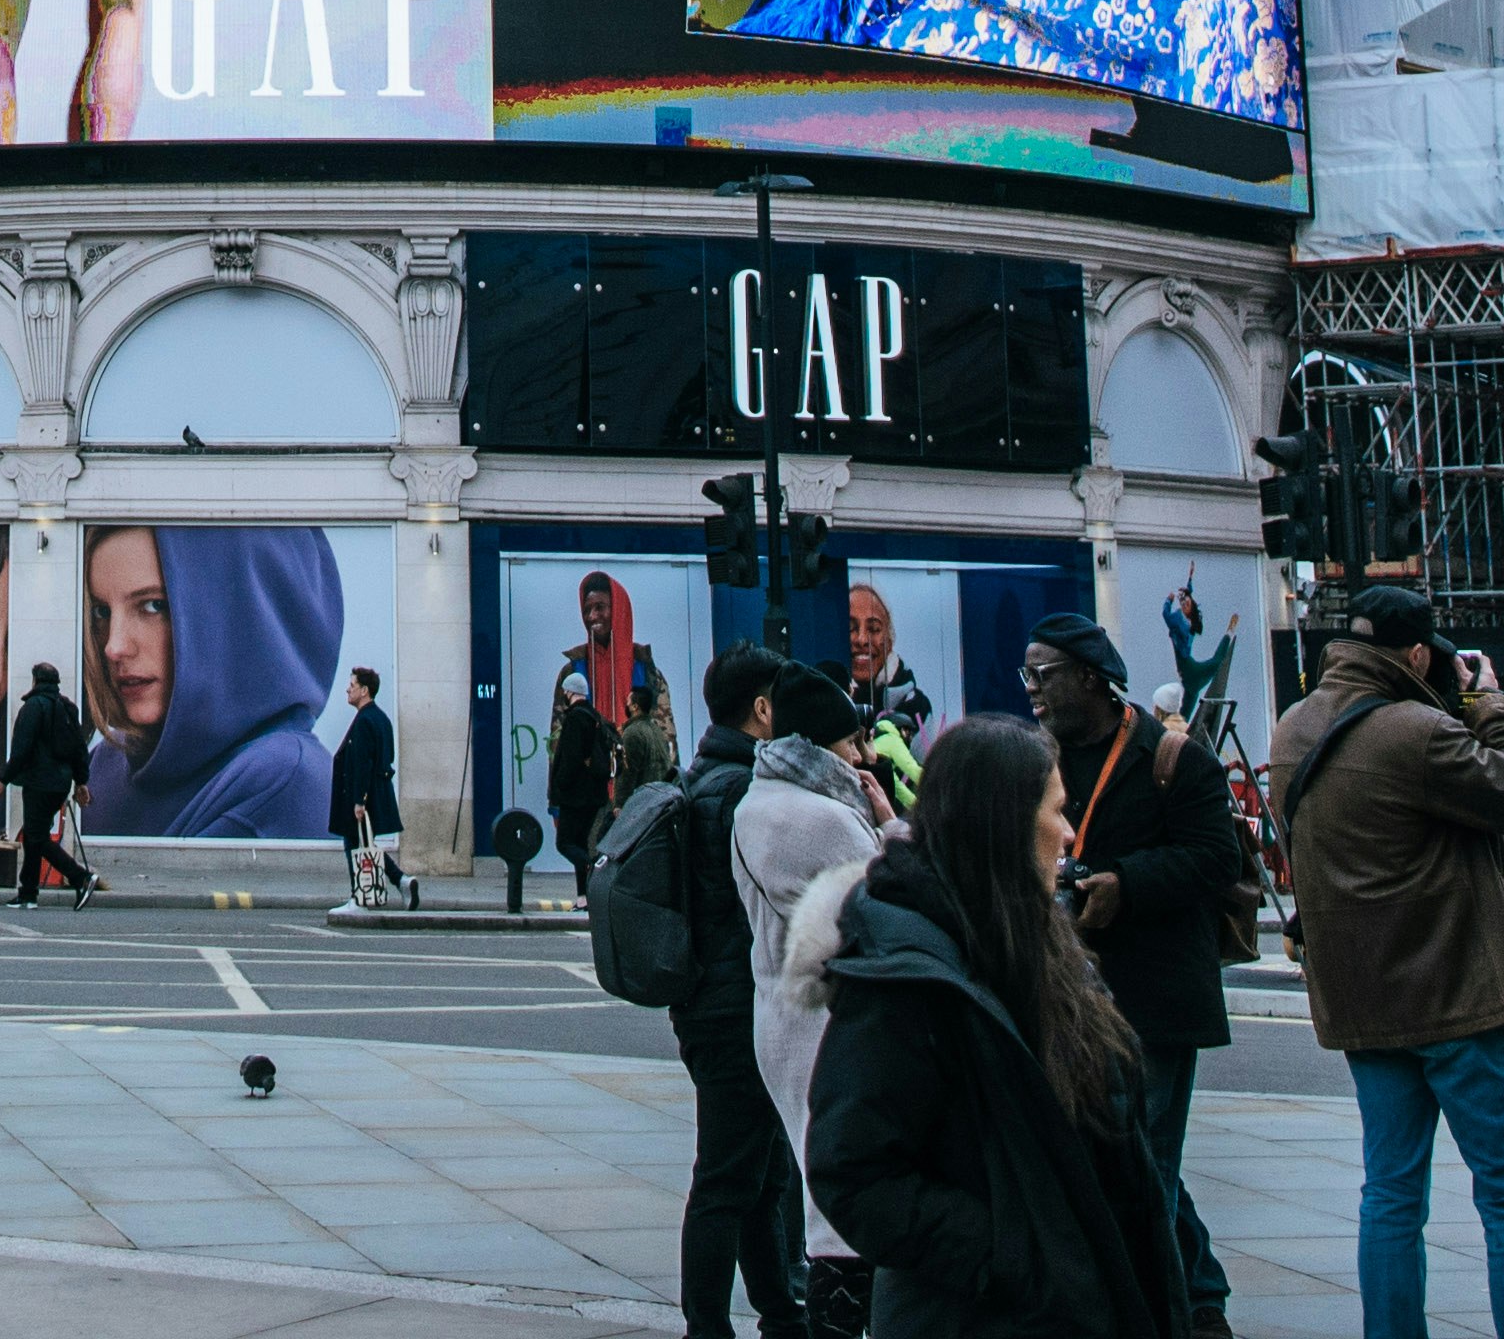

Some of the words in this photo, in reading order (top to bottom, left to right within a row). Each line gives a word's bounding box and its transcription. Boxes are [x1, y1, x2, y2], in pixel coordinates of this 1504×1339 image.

[729, 268, 904, 422] GAP
[477, 684, 496, 699] GAP
[516, 829, 521, 839] 1
